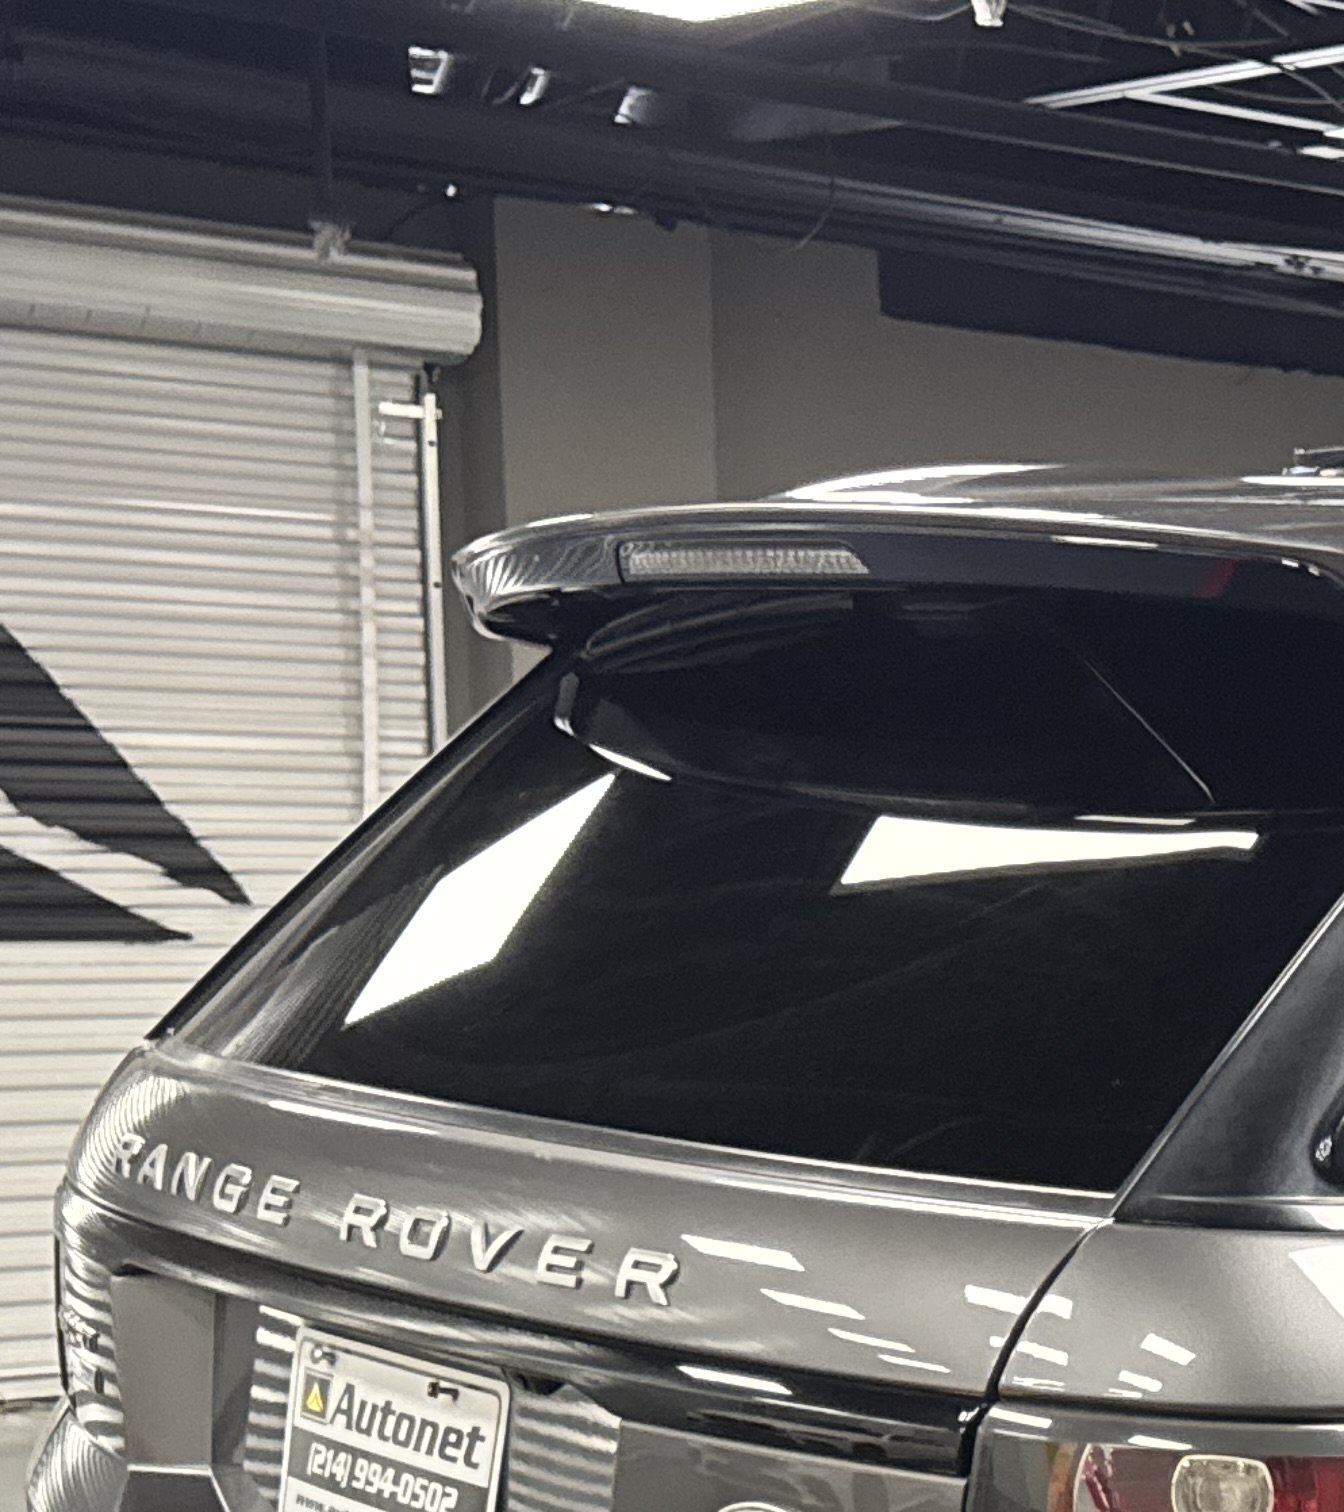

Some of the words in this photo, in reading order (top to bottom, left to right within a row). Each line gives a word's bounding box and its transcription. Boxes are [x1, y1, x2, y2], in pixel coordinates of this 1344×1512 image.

[110, 1132, 300, 1226] RANGE
[340, 1193, 681, 1306] ROVER
[307, 1441, 352, 1489] (214)
[330, 1382, 486, 1470] Autonet
